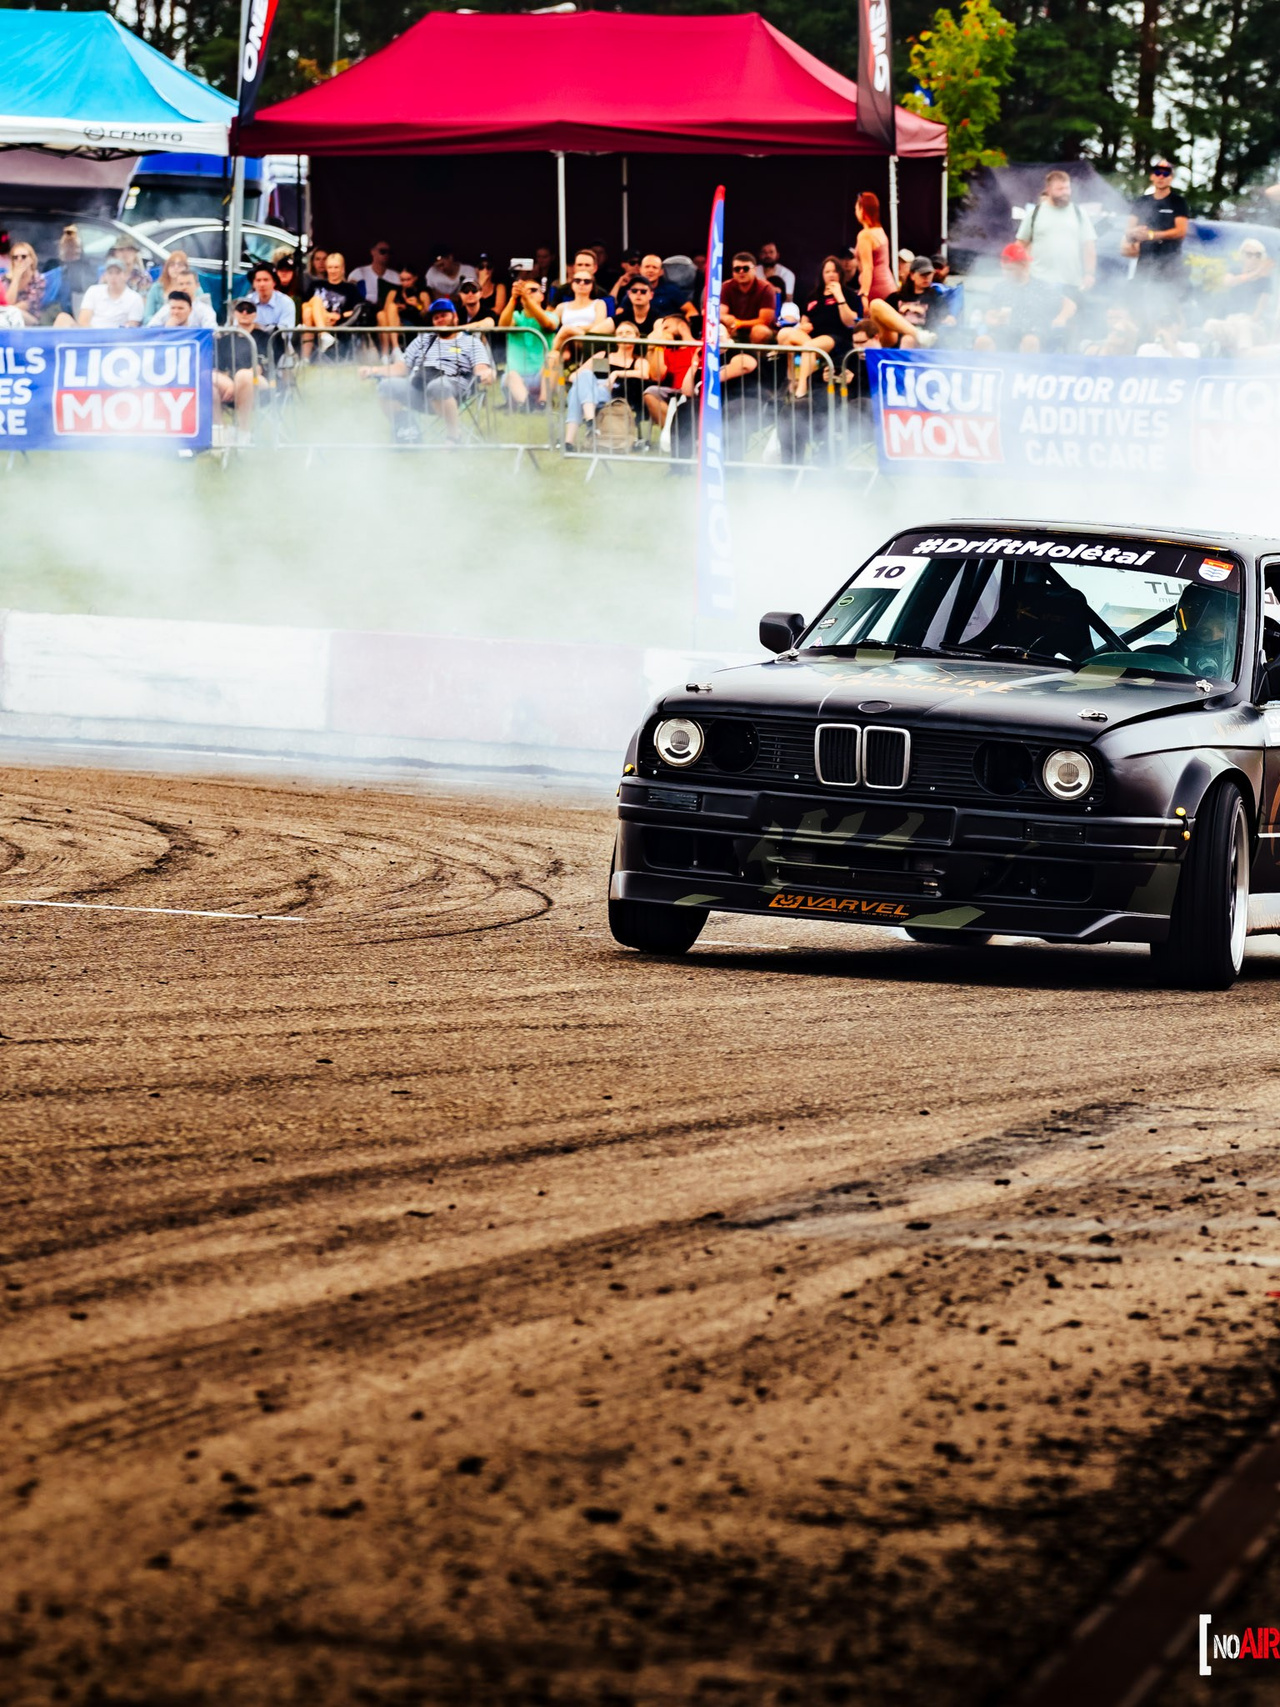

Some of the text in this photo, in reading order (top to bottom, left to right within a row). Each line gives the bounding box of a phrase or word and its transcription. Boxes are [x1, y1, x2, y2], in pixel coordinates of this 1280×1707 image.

[63, 346, 192, 388] LIQUI
[886, 366, 996, 414] LIQUI
[1011, 372, 1185, 405] MOTOR OILS
[61, 391, 194, 431] MOLY
[1019, 406, 1169, 439] ADDITIVES
[886, 414, 996, 458] MOLY
[1025, 440, 1167, 472] CAR CARE
[872, 565, 906, 580] 10
[805, 896, 910, 917] VARVEL
